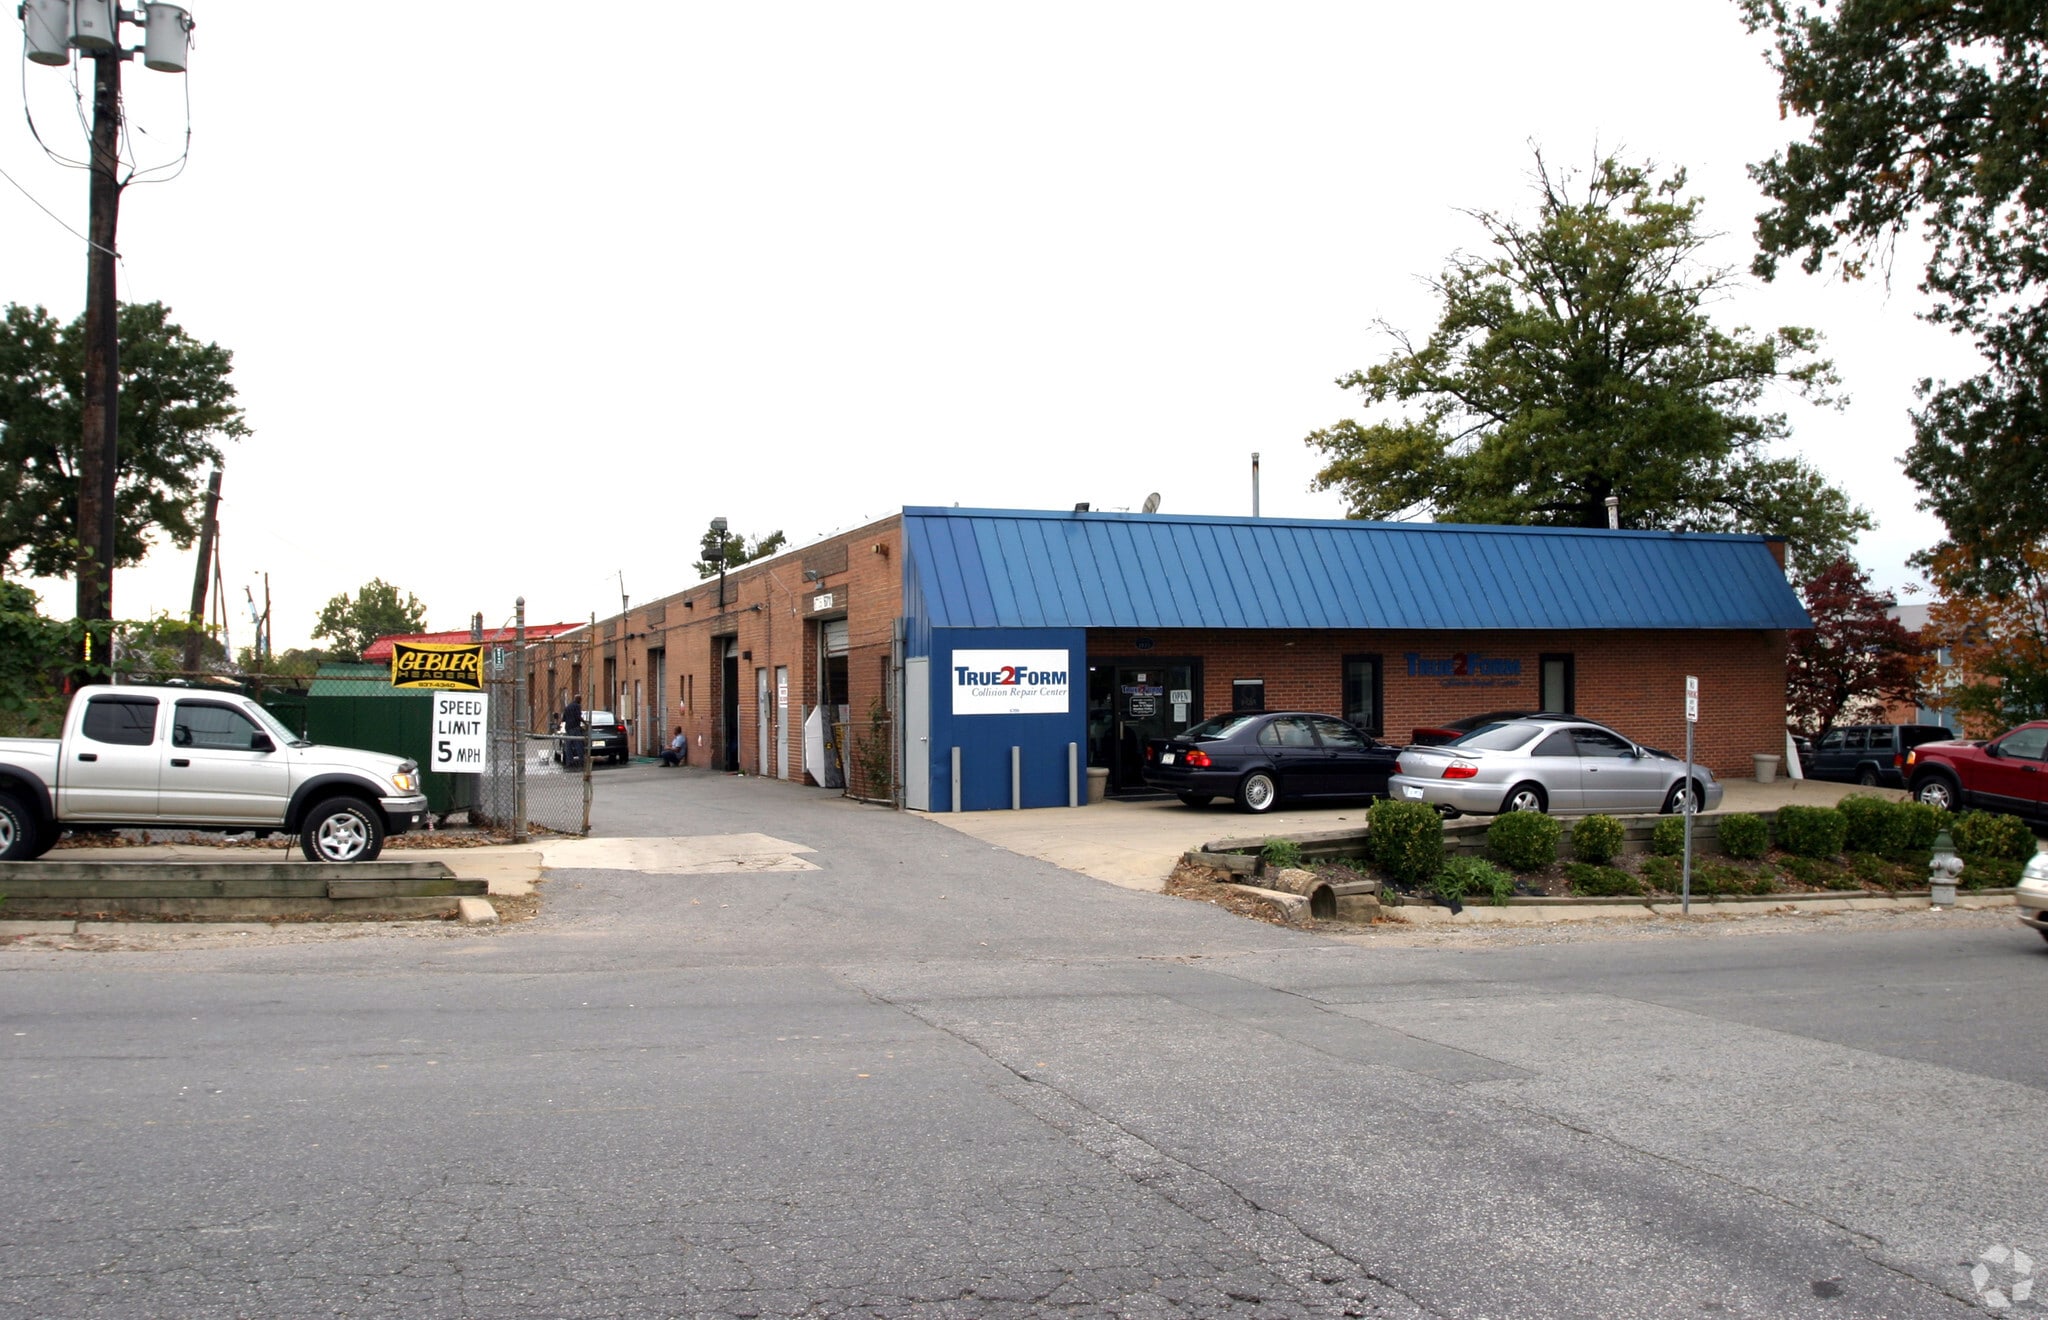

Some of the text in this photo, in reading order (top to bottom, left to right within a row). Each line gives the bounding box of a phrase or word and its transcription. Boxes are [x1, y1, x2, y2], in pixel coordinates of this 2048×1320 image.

[398, 651, 478, 672] GEBLER
[1403, 652, 1520, 676] TRUE2FORM
[398, 670, 477, 679] HEADERS
[954, 665, 1067, 686] TRUE2FORM
[971, 686, 1067, 698] Collision Repair Center
[1171, 691, 1188, 702] OPEN
[440, 700, 481, 715] SPEED
[439, 720, 481, 735] LIMIT
[438, 741, 481, 763] 5 MPH
